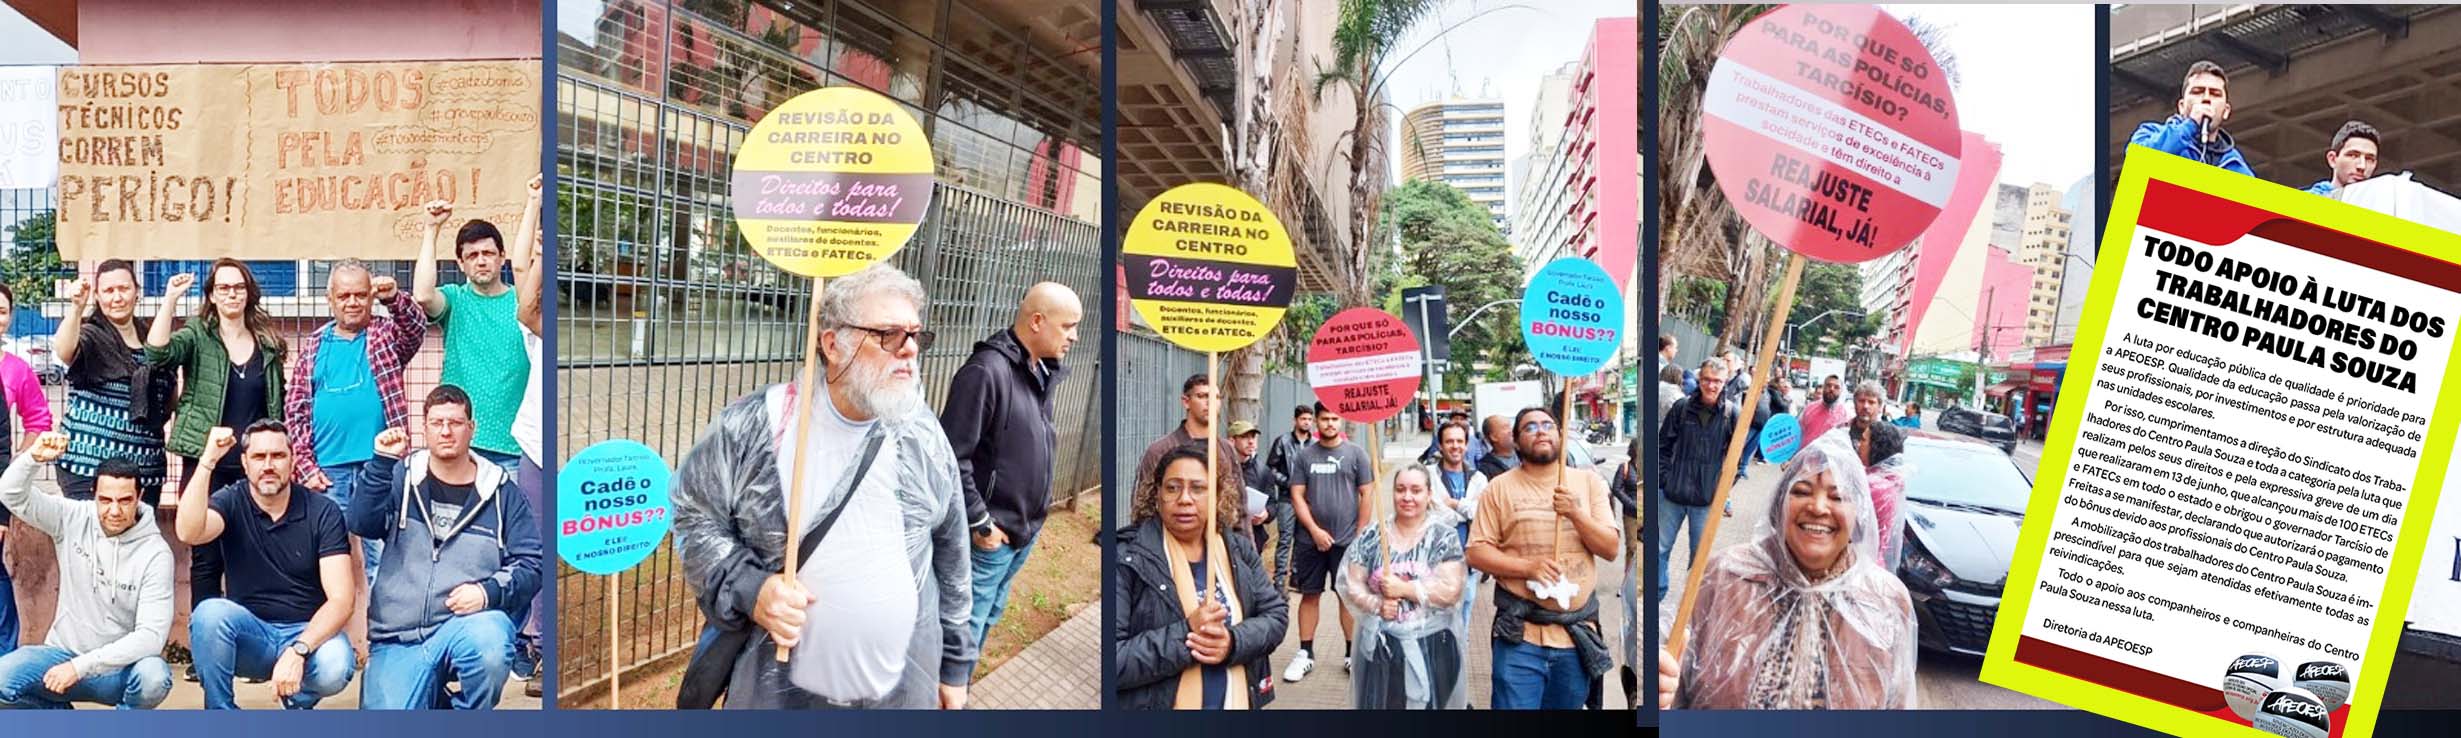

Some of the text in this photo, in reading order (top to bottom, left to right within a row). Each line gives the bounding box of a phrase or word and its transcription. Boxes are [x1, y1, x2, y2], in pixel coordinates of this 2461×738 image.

[1802, 12, 1929, 80] POR QUE SÓ
[1762, 19, 1950, 120] PARA AS POLÍCIAS,
[61, 70, 169, 98] CURSOS
[275, 68, 424, 118] TODOS
[1796, 60, 1909, 122] TARCÍSIO?
[59, 102, 183, 130] TÉCNICOS
[778, 110, 895, 126] REVISÃO DA
[1732, 71, 1945, 171] Trabalhadores das ETECs e FATECs
[1735, 91, 1790, 120] prestam
[1790, 115, 1843, 143] serviços
[1845, 134, 1861, 150] de
[59, 135, 164, 166] CORREM
[277, 131, 365, 169] PELA
[768, 132, 902, 145] CARREIRA NO
[1761, 119, 1902, 185] socidade e têm direito a
[790, 151, 873, 165] CENTRO
[760, 174, 899, 201] Direitos para
[1770, 152, 1873, 213] REAJUSTE
[60, 170, 237, 223] PERIGO!
[755, 197, 903, 218] todos e todas!
[1160, 201, 1262, 222] REVISÃO DA
[1744, 177, 1879, 249] SALARIAL, JÁ!
[1152, 219, 1269, 241] CARREIRA NO
[1175, 239, 1248, 256] CENTRO
[1150, 258, 1271, 287] Direitos para
[1147, 280, 1275, 302] todos e todas!
[1547, 290, 1605, 309] Cadê o
[1330, 324, 1351, 334] POR
[1352, 321, 1373, 332] QUE
[1549, 308, 1601, 323] nosso
[1316, 336, 1342, 346] PARA
[1343, 335, 1356, 343] AS
[1531, 320, 1615, 342] BÔNUS??
[1344, 384, 1390, 400] REAJUSTE
[580, 476, 651, 495] Cadê o
[585, 494, 648, 511] nosso
[562, 507, 665, 536] BÔNUS??
